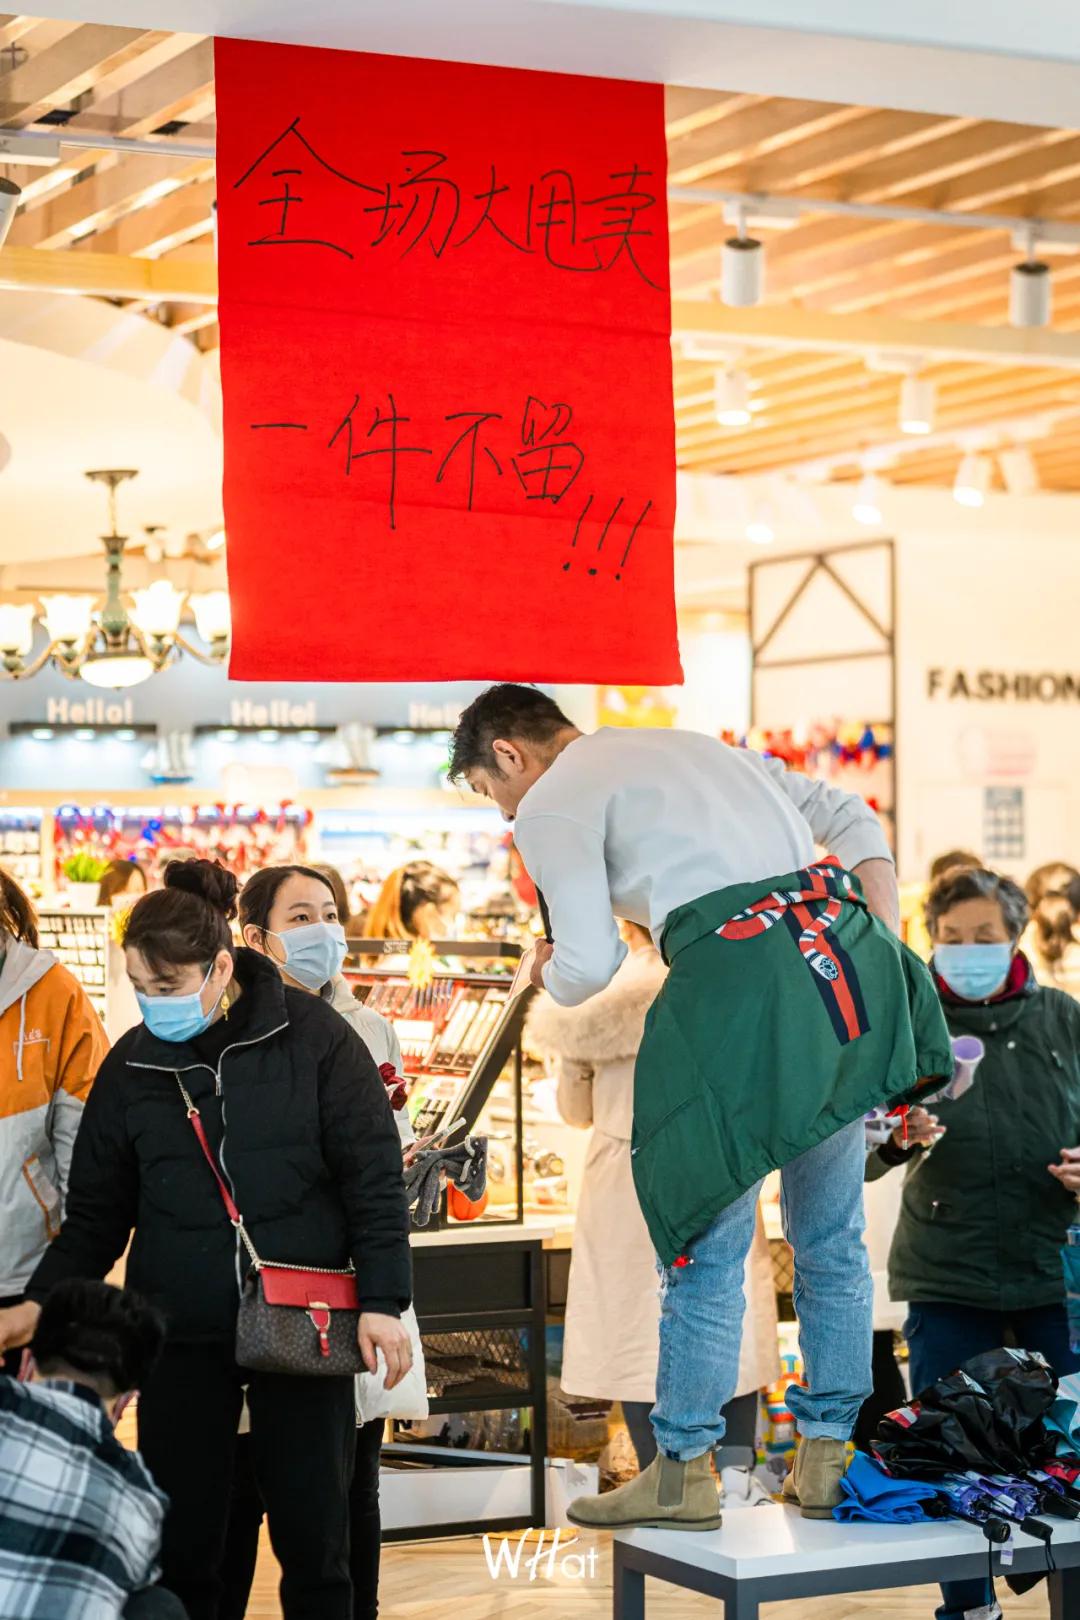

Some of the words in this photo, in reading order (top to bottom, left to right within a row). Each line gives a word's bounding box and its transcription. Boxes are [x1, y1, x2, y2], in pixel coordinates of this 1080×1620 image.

[233, 116, 665, 292] 全场大甩卖
[47, 698, 134, 724] Hello!
[230, 699, 317, 726] Hello!
